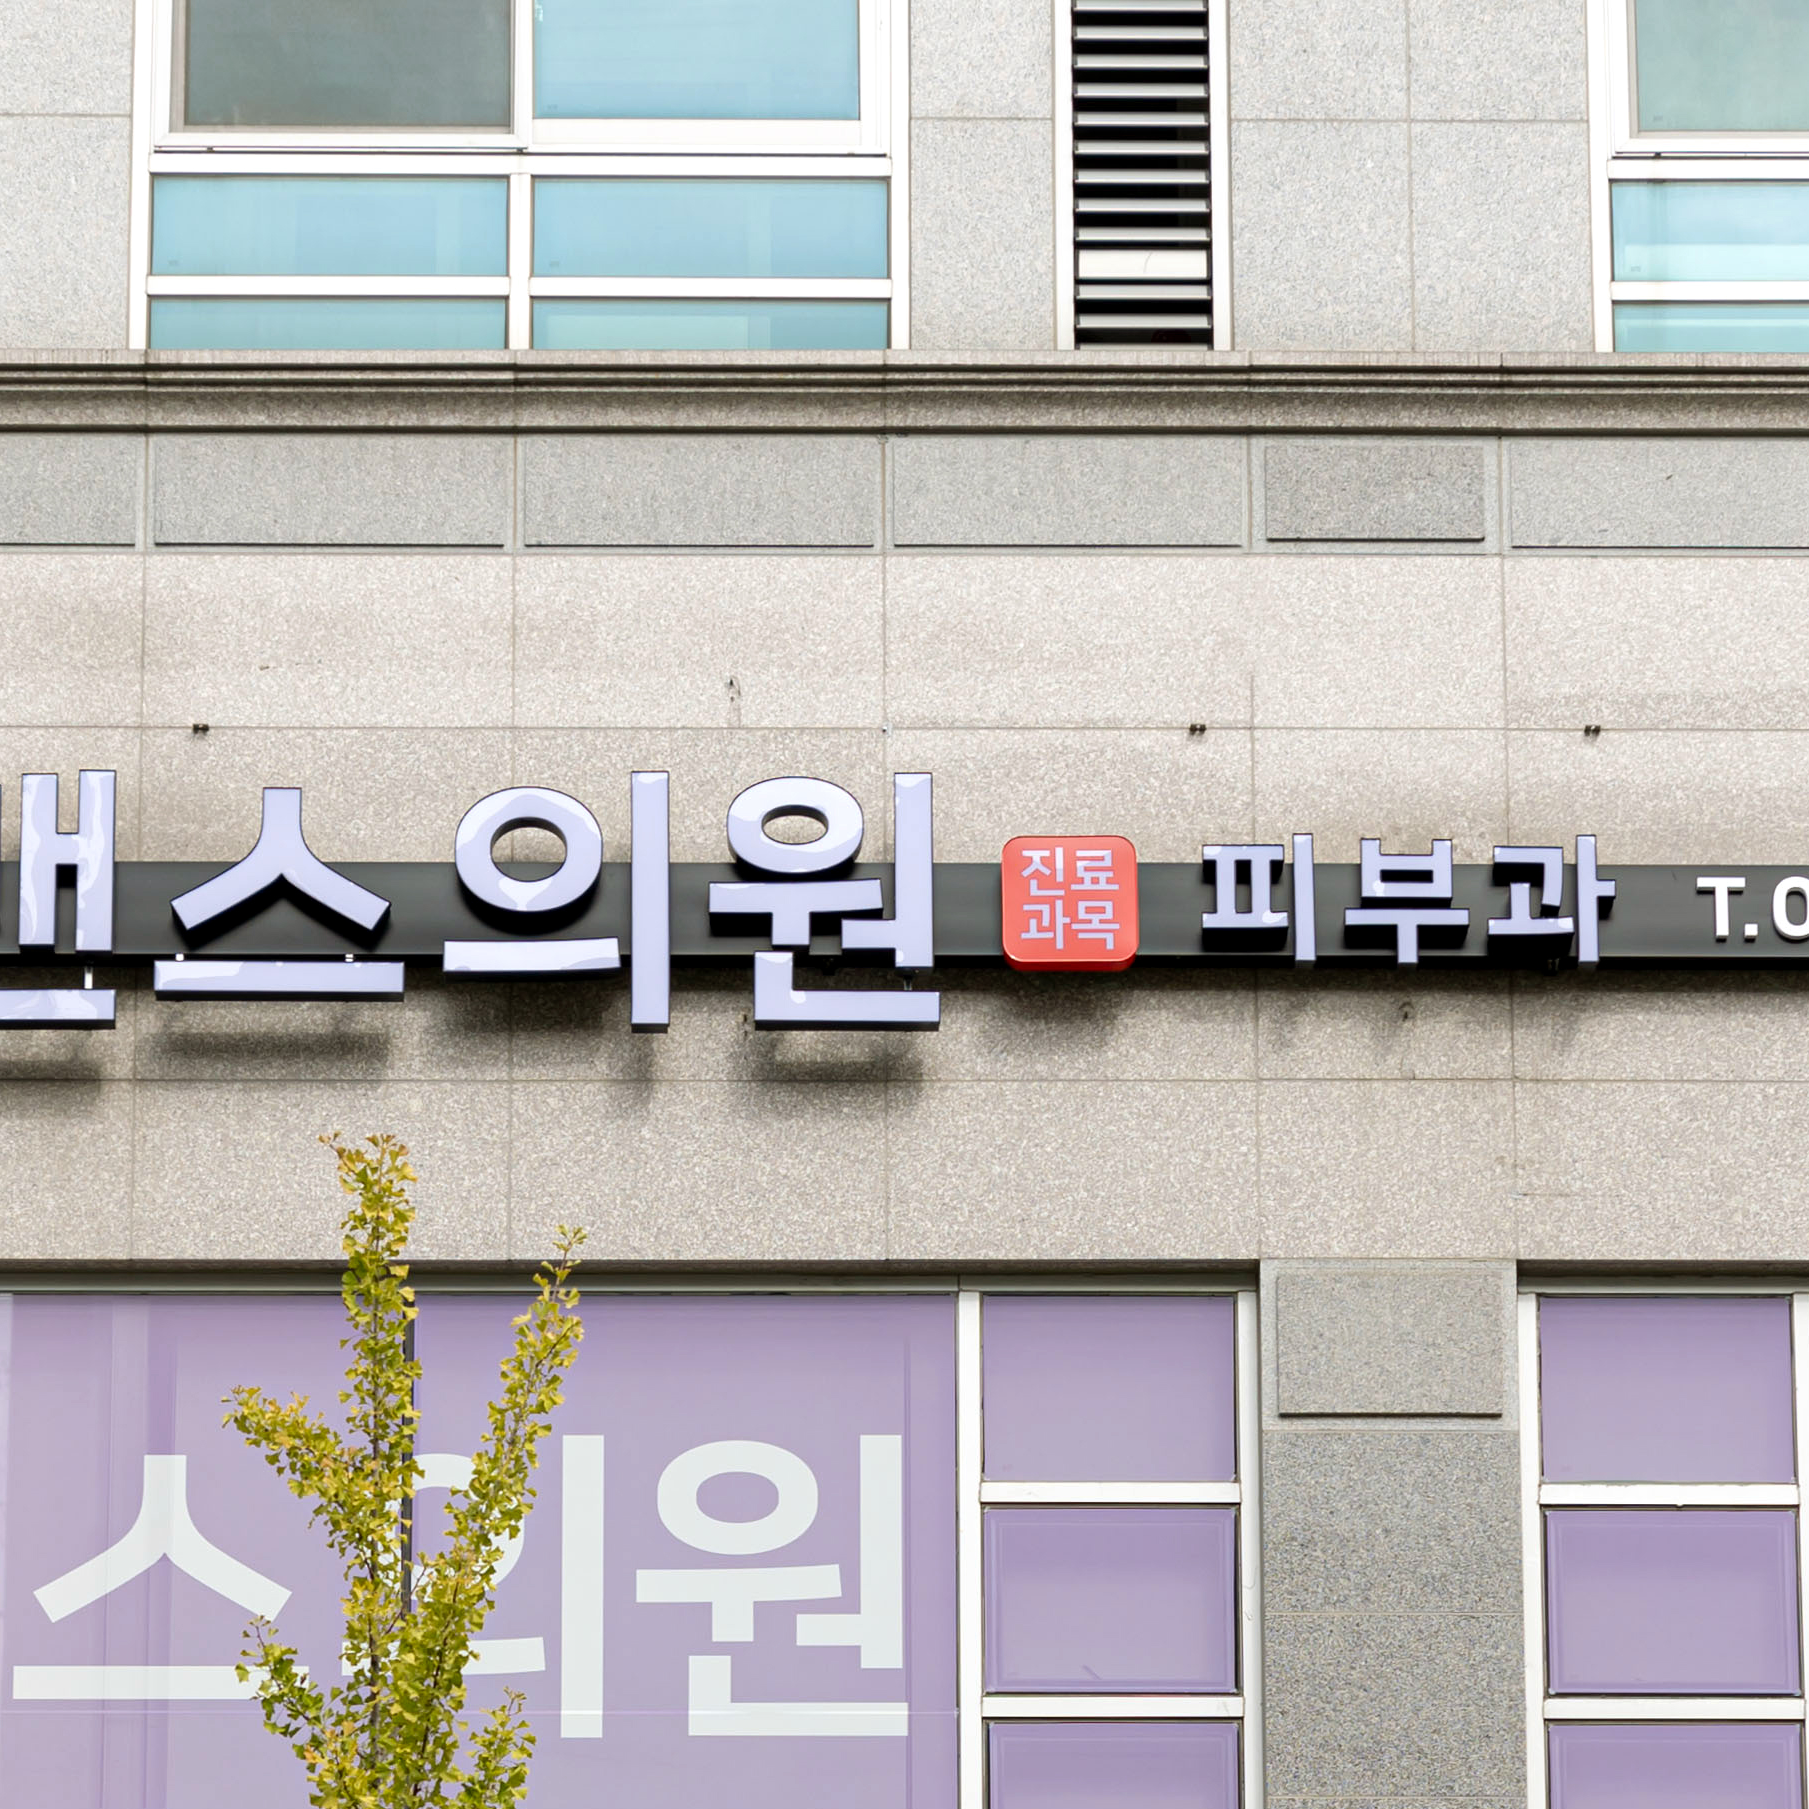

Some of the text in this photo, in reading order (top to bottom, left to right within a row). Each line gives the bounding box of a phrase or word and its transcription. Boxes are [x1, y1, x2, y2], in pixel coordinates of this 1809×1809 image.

[1020, 846, 1121, 897] 진료
[1201, 832, 1617, 965] 피부과
[1020, 900, 1121, 950] 과목
